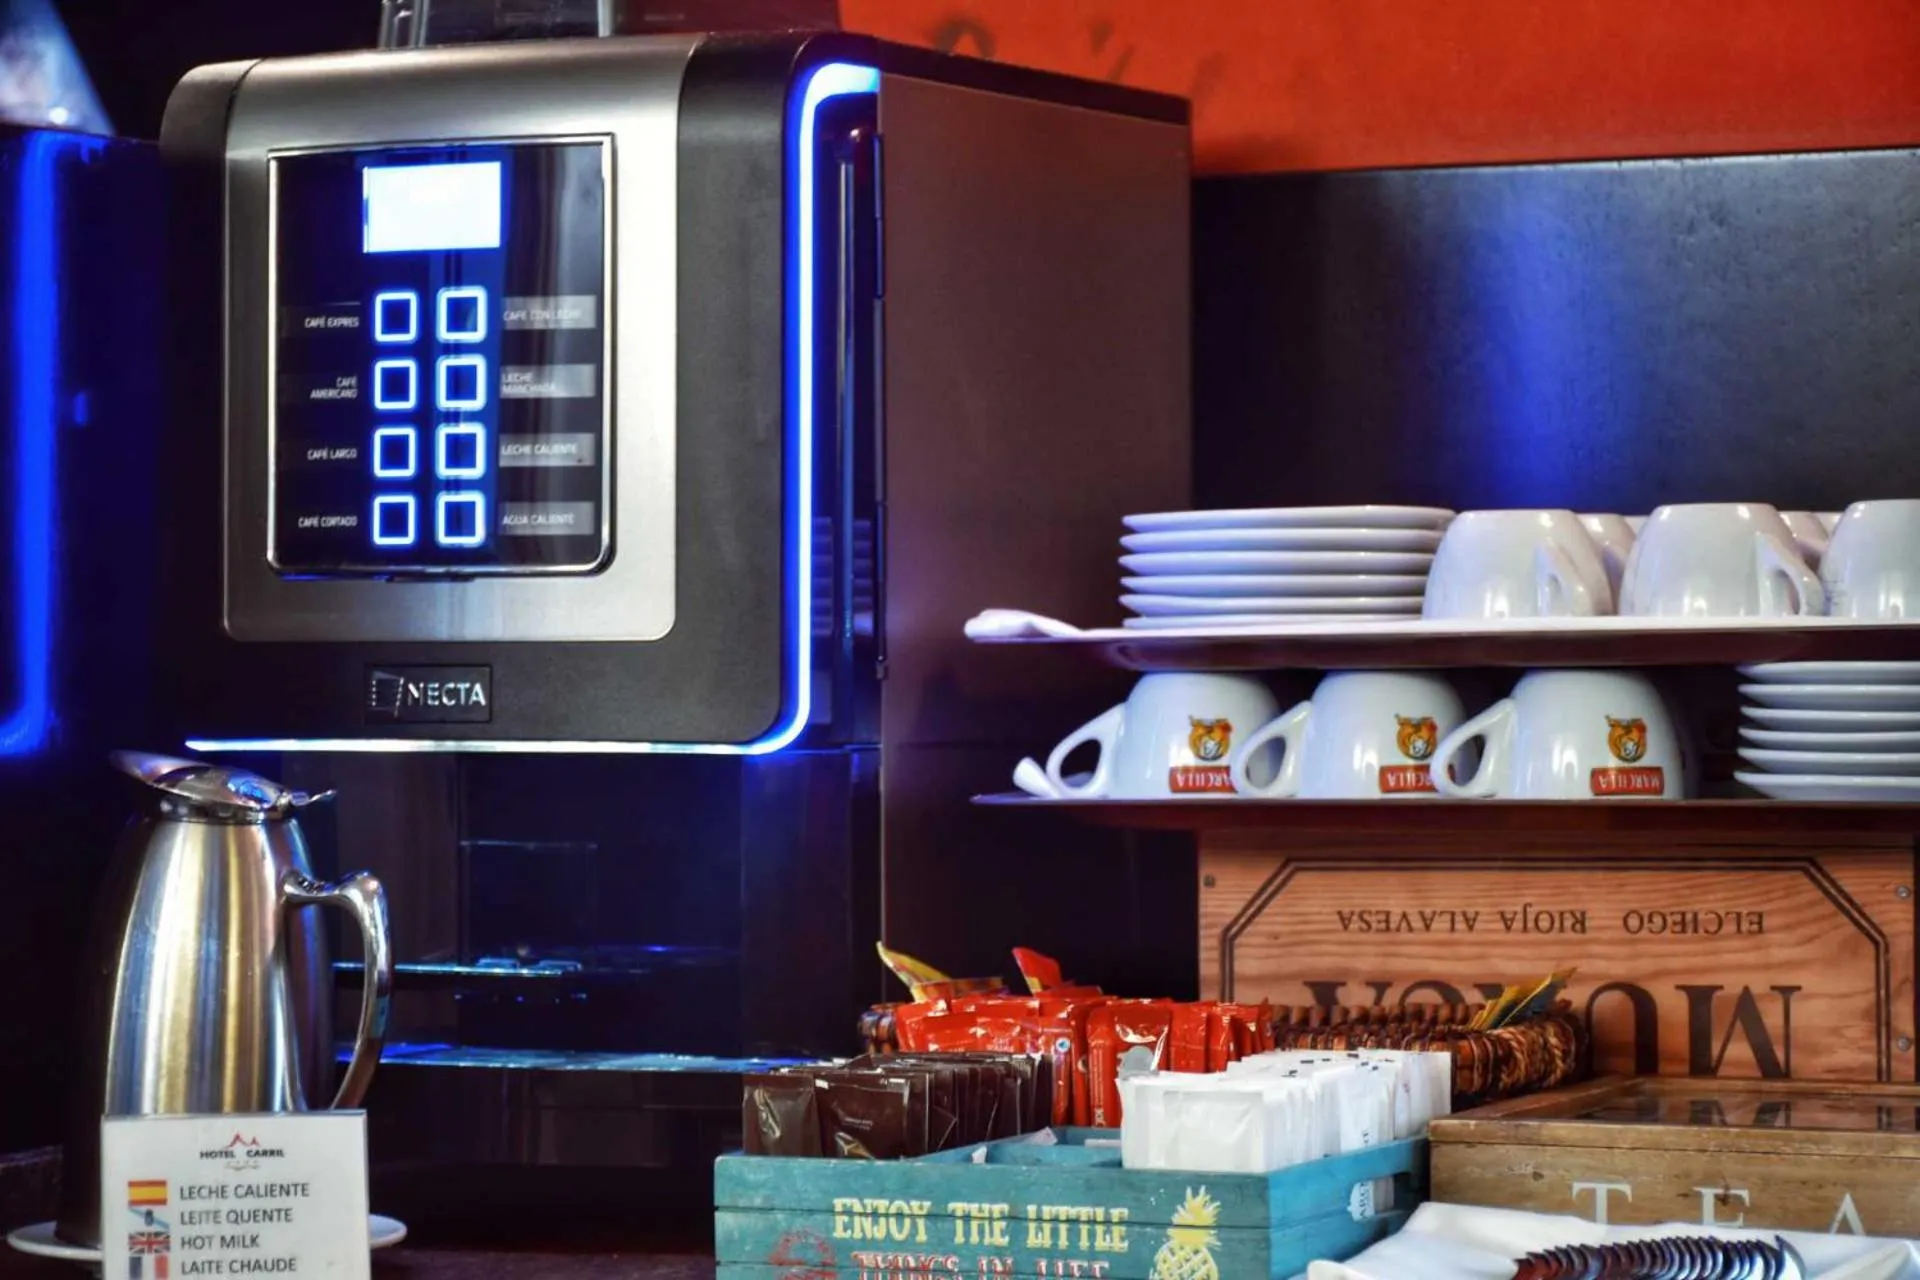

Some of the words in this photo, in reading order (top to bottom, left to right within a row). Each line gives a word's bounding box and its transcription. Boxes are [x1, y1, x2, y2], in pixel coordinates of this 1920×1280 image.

[502, 444, 531, 455] LECHE
[534, 443, 577, 455] CALIENTE
[503, 515, 528, 525] AGUA
[531, 513, 574, 525] CALIENTE
[407, 682, 486, 706] NECTA
[1599, 774, 1660, 790] MARCILLA
[1336, 910, 1479, 932] ALAVESA
[1500, 903, 1587, 935] RIOJA
[1622, 910, 1764, 935] ELCIEGO
[199, 1149, 236, 1159] HOTEL
[246, 1148, 285, 1158] CARRIL
[180, 1184, 229, 1200] LECHE
[233, 1183, 310, 1199] CALIENTE
[180, 1209, 222, 1225] LEITE
[226, 1208, 293, 1224] QUENTE
[832, 1196, 932, 1243] ENJOY
[948, 1201, 1010, 1246] THE
[1026, 1204, 1129, 1251] LITTLE
[180, 1234, 215, 1250] HOT
[220, 1233, 260, 1249] MILK
[181, 1259, 223, 1275] LAITE
[229, 1257, 297, 1274] CHAUDE
